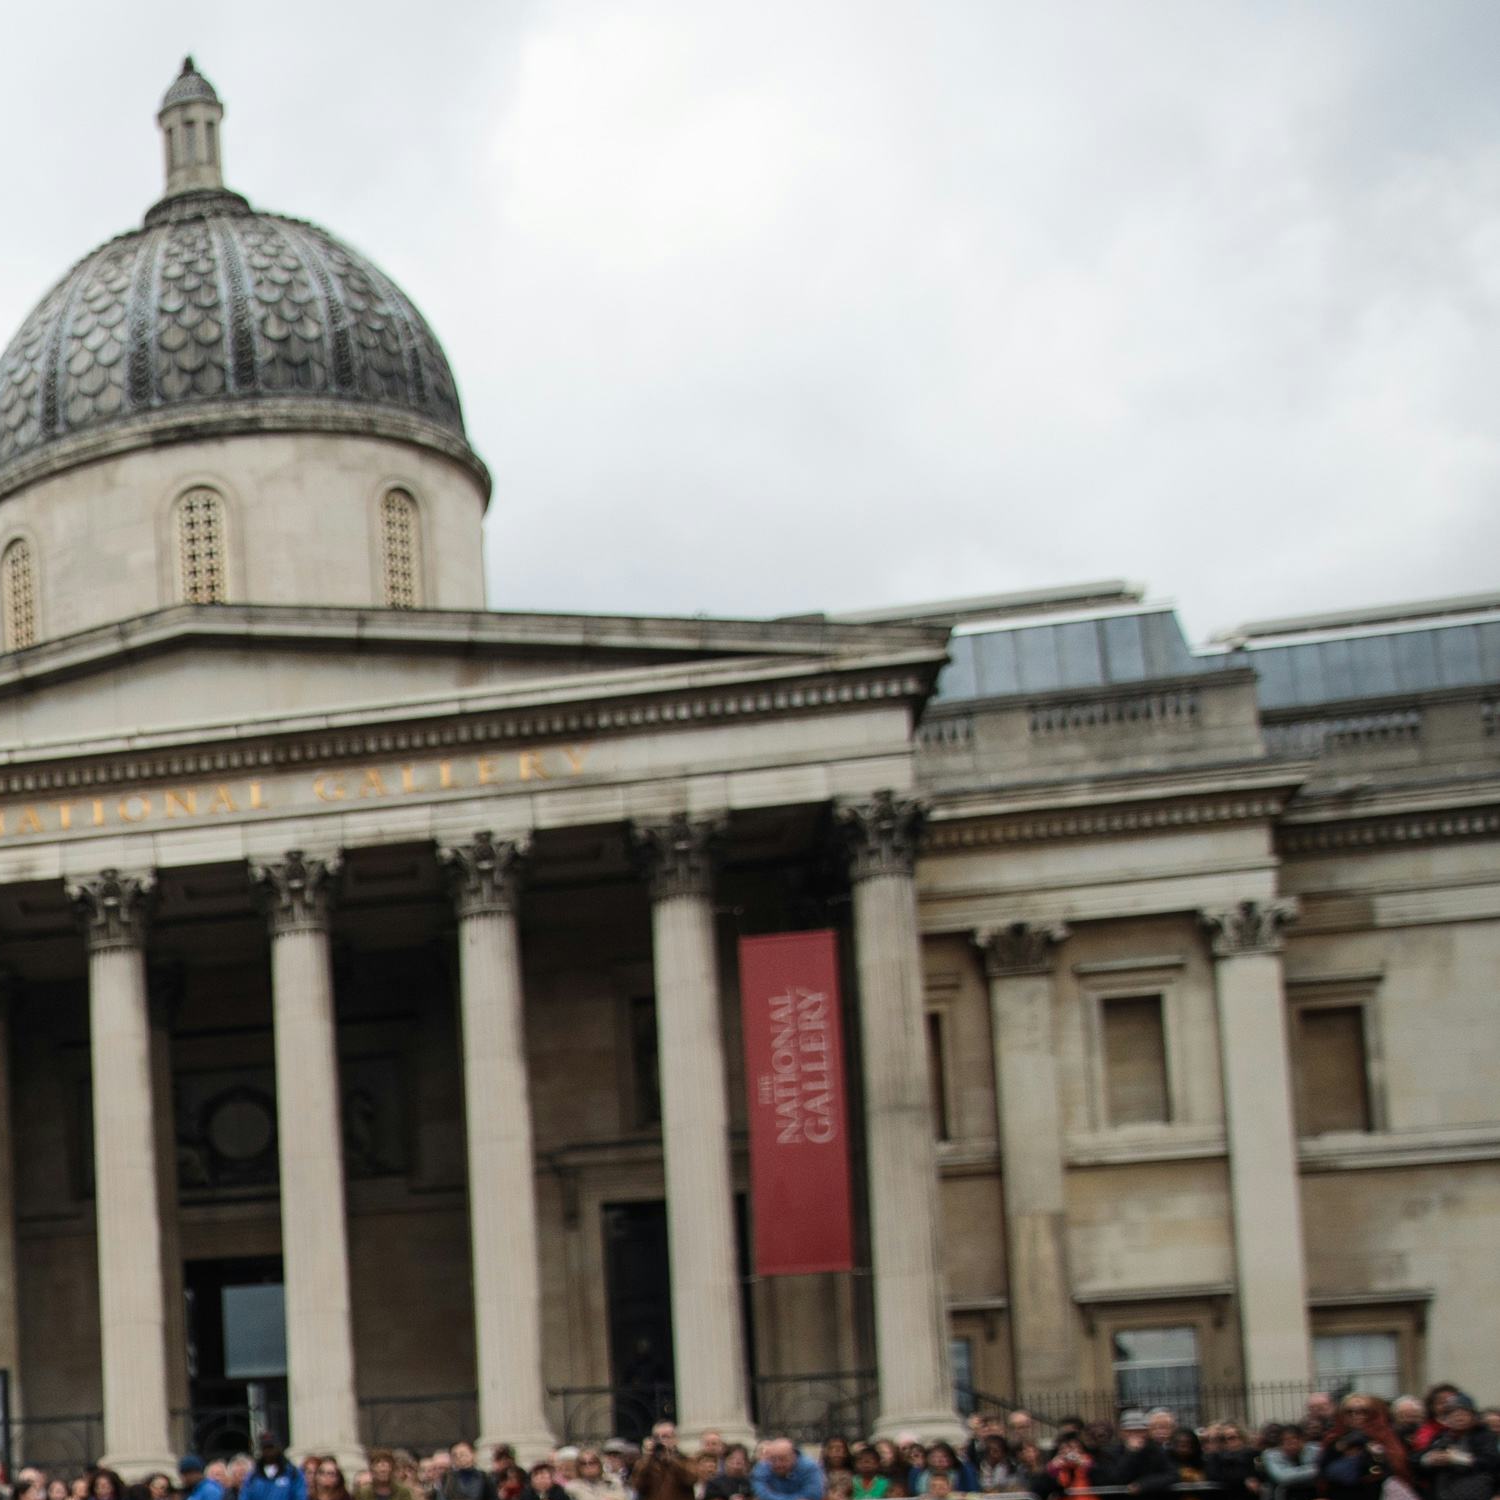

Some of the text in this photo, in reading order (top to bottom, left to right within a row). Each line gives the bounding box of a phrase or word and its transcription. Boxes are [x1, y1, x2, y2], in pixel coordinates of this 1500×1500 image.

[313, 749, 595, 802] GALLERY
[769, 985, 802, 1144] NATIONAL
[798, 986, 838, 1144] GALLERY
